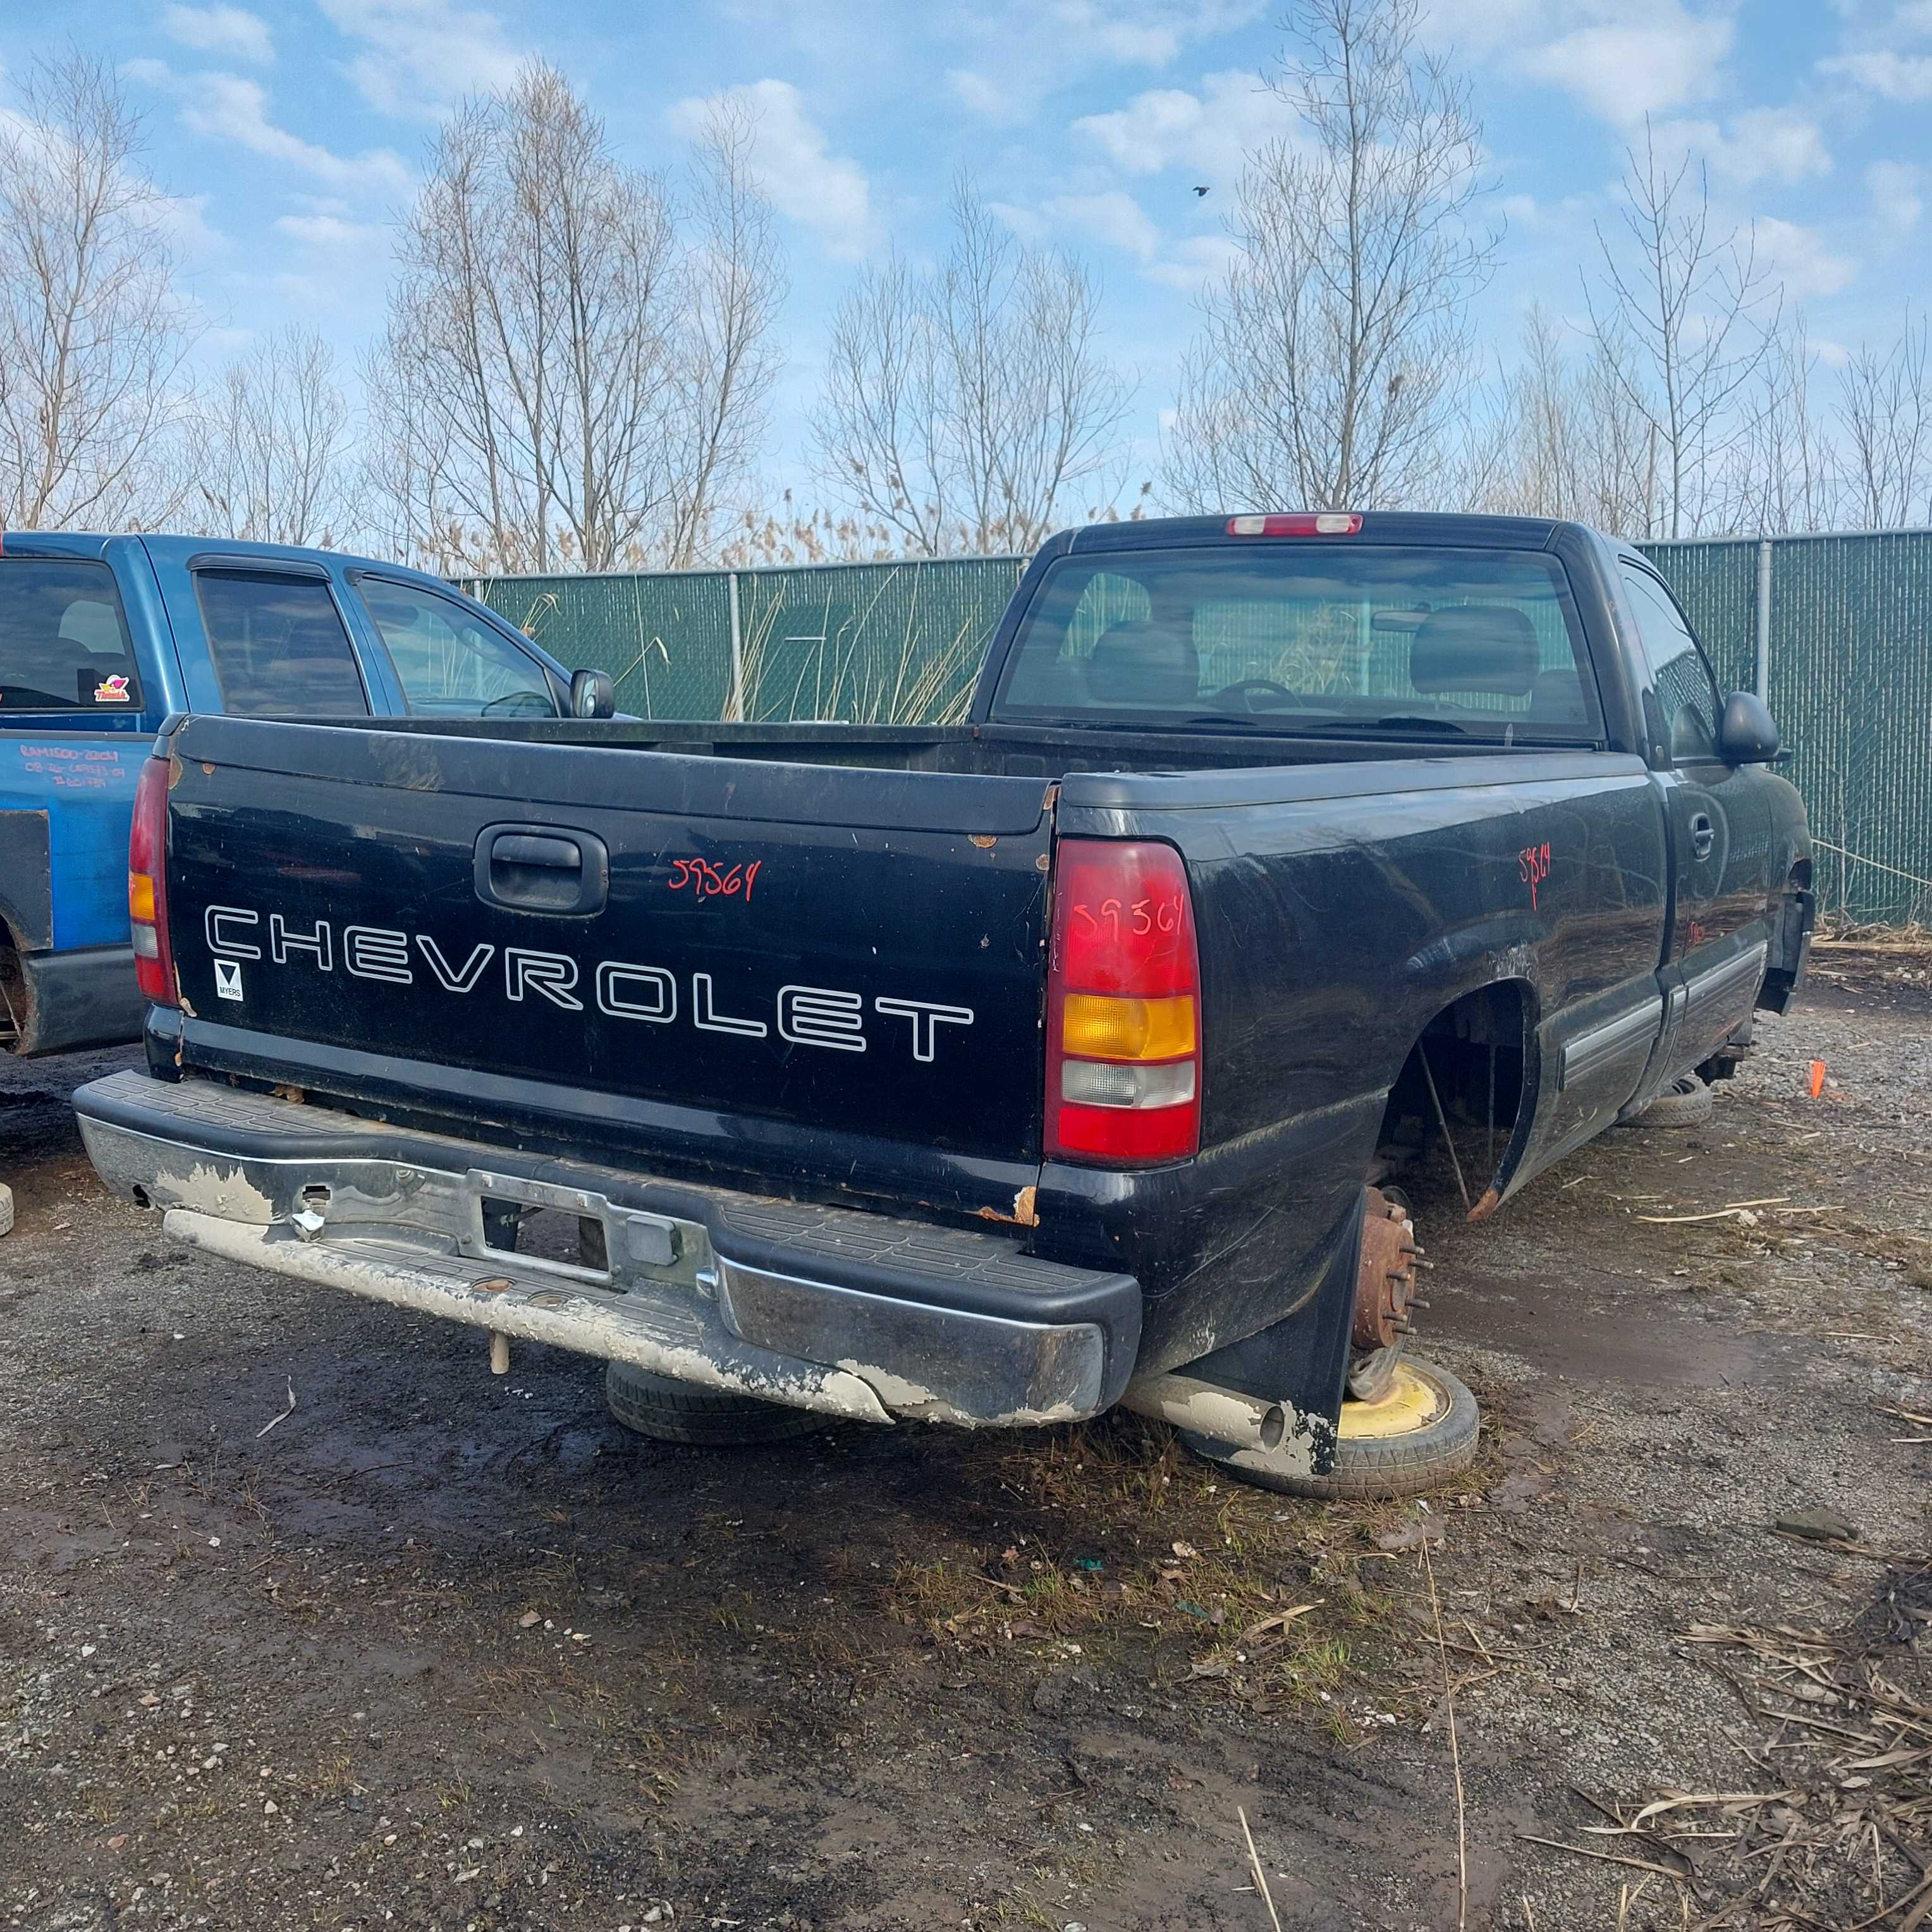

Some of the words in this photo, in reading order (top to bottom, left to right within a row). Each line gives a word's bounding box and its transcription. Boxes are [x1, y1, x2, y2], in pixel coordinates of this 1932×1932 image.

[668, 858, 761, 902] 59564
[205, 905, 974, 1061] CHEVROLET
[219, 986, 241, 997] MYERS
